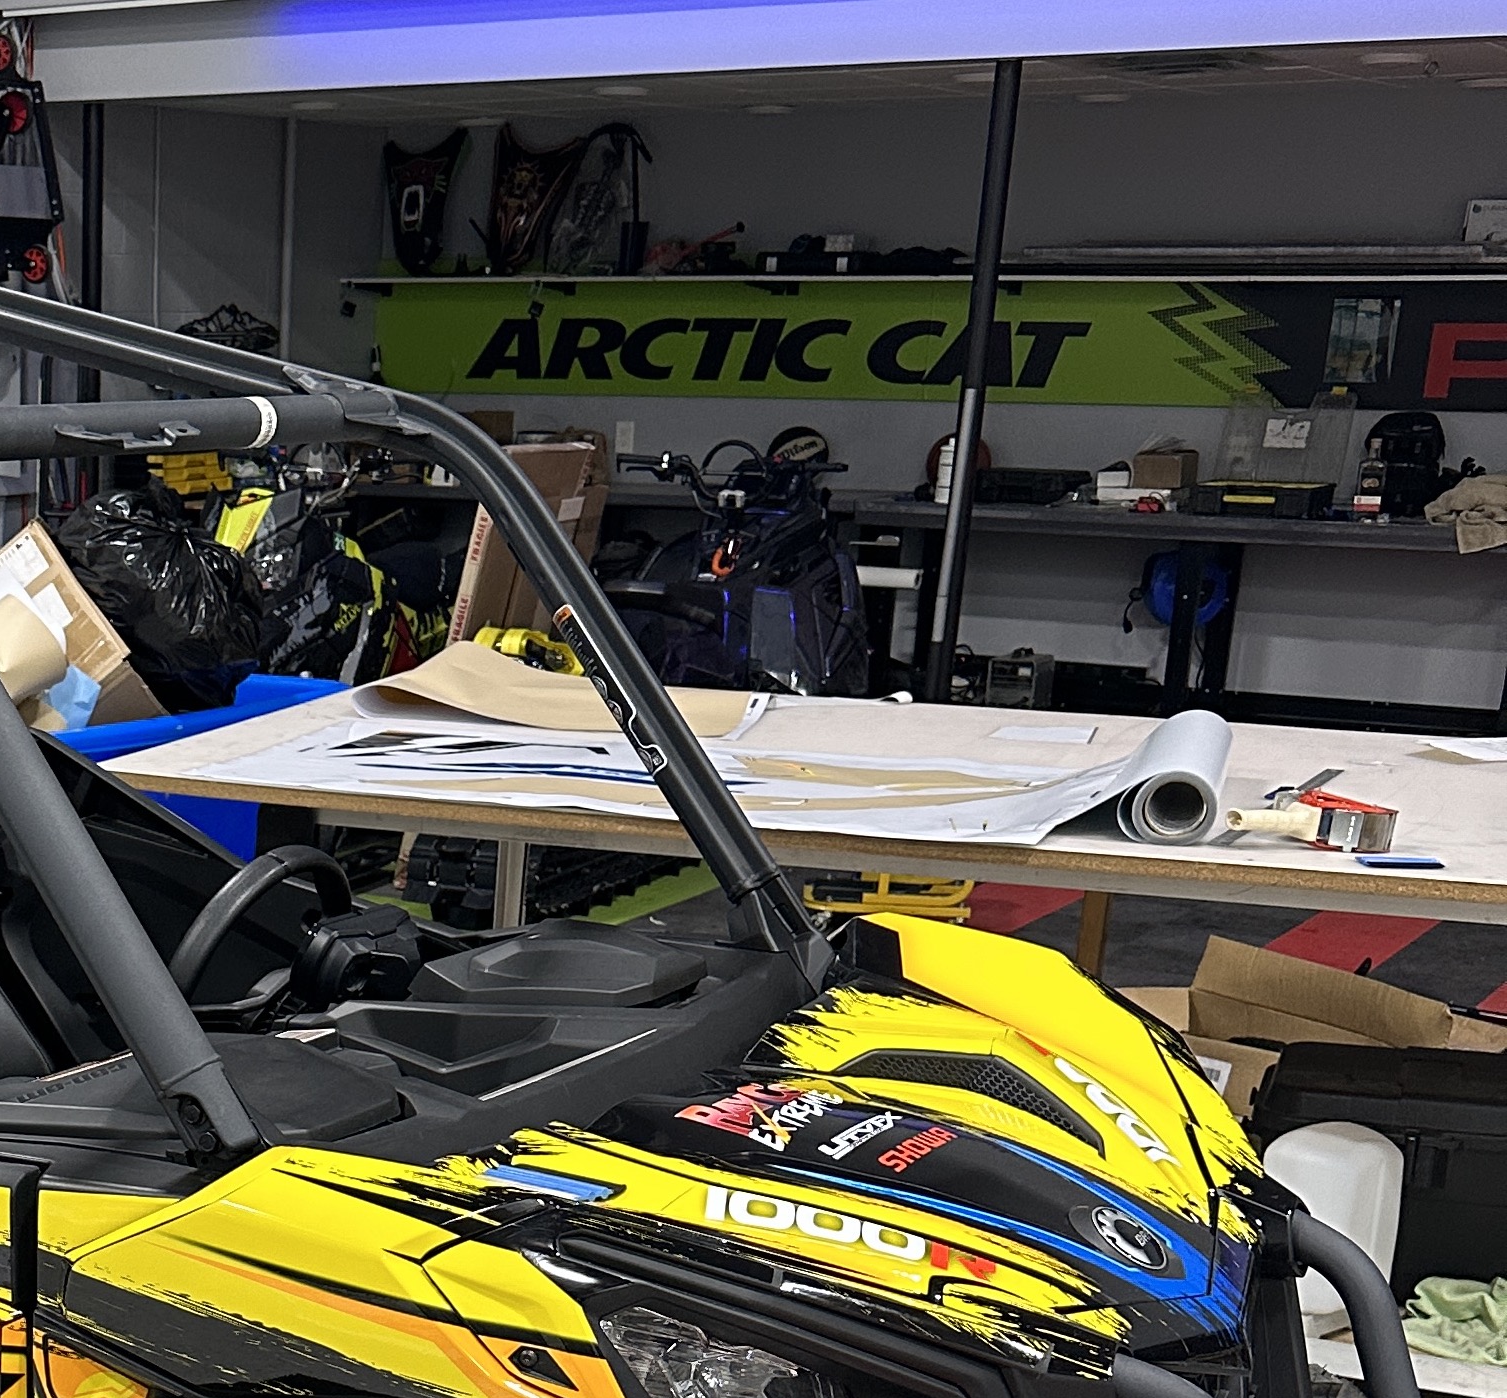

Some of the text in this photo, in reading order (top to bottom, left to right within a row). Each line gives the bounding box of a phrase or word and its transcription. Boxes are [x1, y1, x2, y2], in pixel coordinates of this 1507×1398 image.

[466, 318, 1092, 388] ARCTIC CAT
[471, 515, 489, 562] FRAGILE
[451, 597, 470, 641] FRAGILE
[877, 1127, 958, 1173] SHOWA
